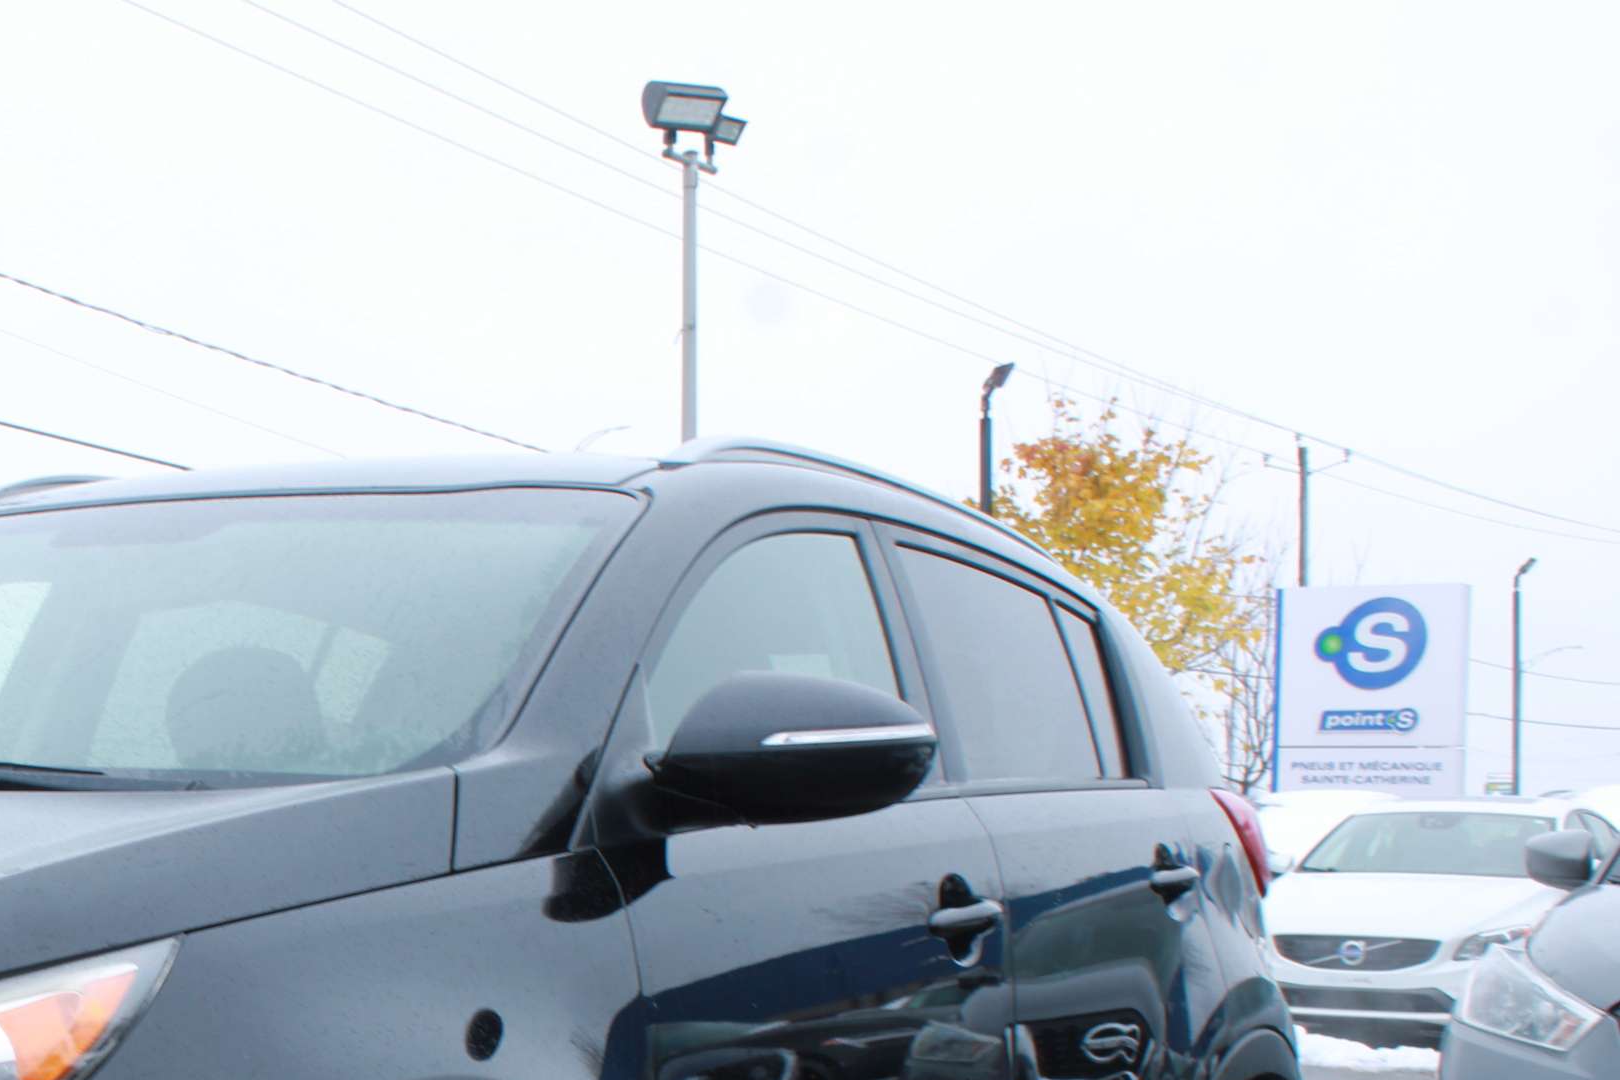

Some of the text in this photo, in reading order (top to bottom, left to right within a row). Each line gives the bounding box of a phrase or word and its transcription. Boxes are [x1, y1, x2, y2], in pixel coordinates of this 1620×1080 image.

[1346, 611, 1411, 673] S
[1325, 712, 1385, 728] point
[1291, 761, 1335, 771] PNEUS
[1339, 761, 1355, 771] ET
